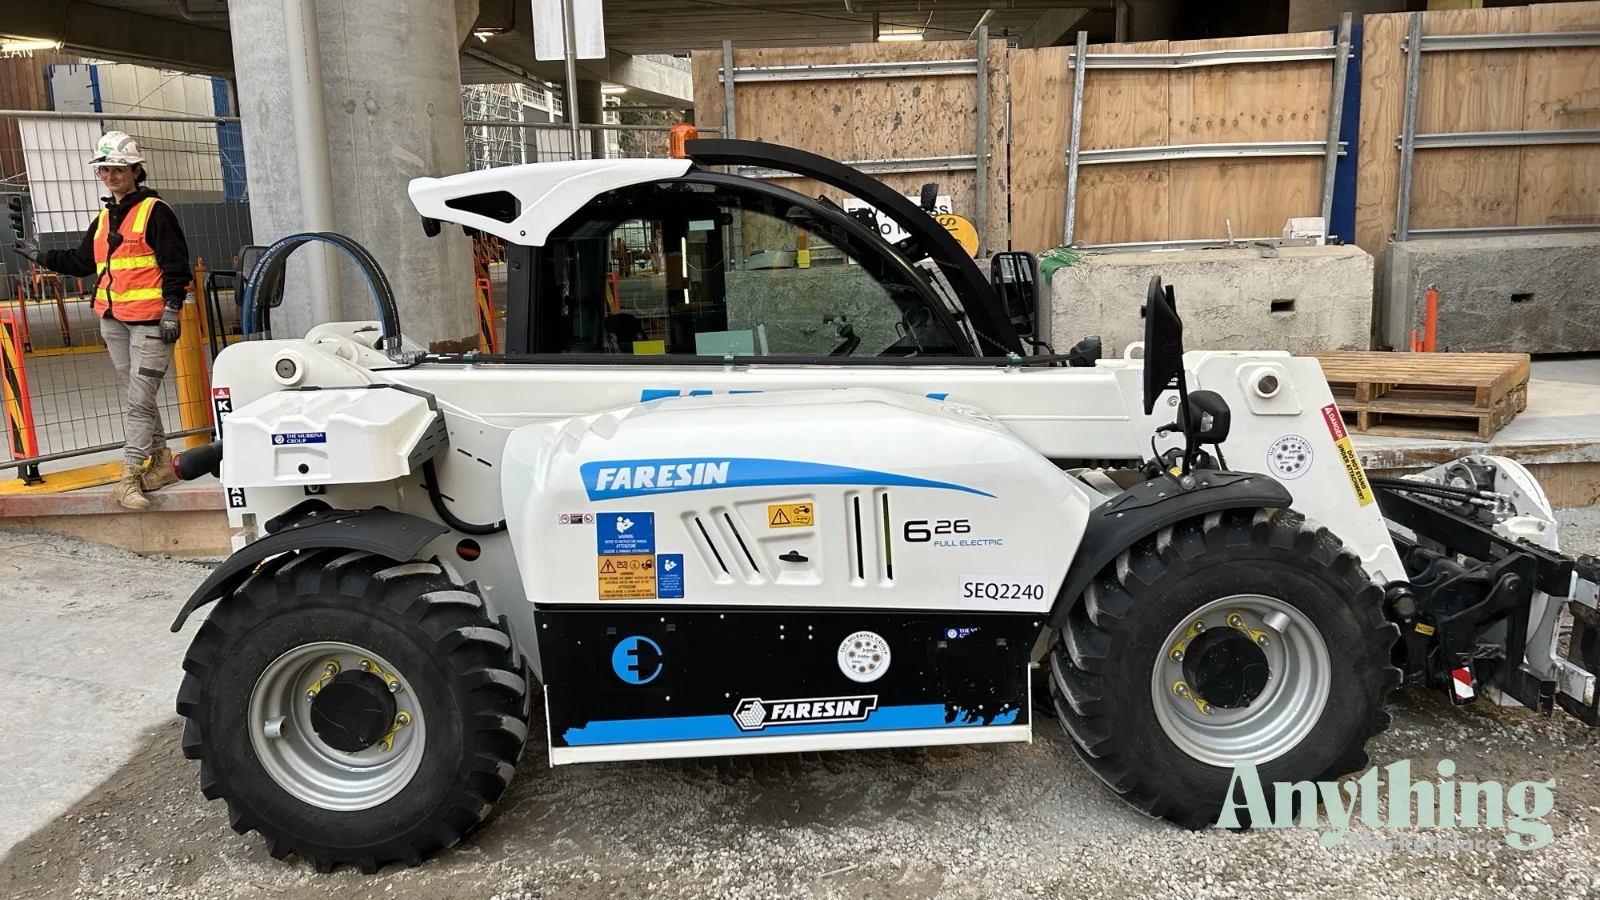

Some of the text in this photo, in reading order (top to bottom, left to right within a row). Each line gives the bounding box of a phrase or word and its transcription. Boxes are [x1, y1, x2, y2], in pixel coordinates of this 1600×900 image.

[1328, 413, 1343, 439] DANGER
[595, 461, 731, 491] FARESIN
[1338, 443, 1365, 500] UNDER ATTACHMENT
[1346, 449, 1367, 490] DO NOT STAND
[963, 582, 1044, 601] SEQ2240
[770, 700, 861, 720] FARESIN
